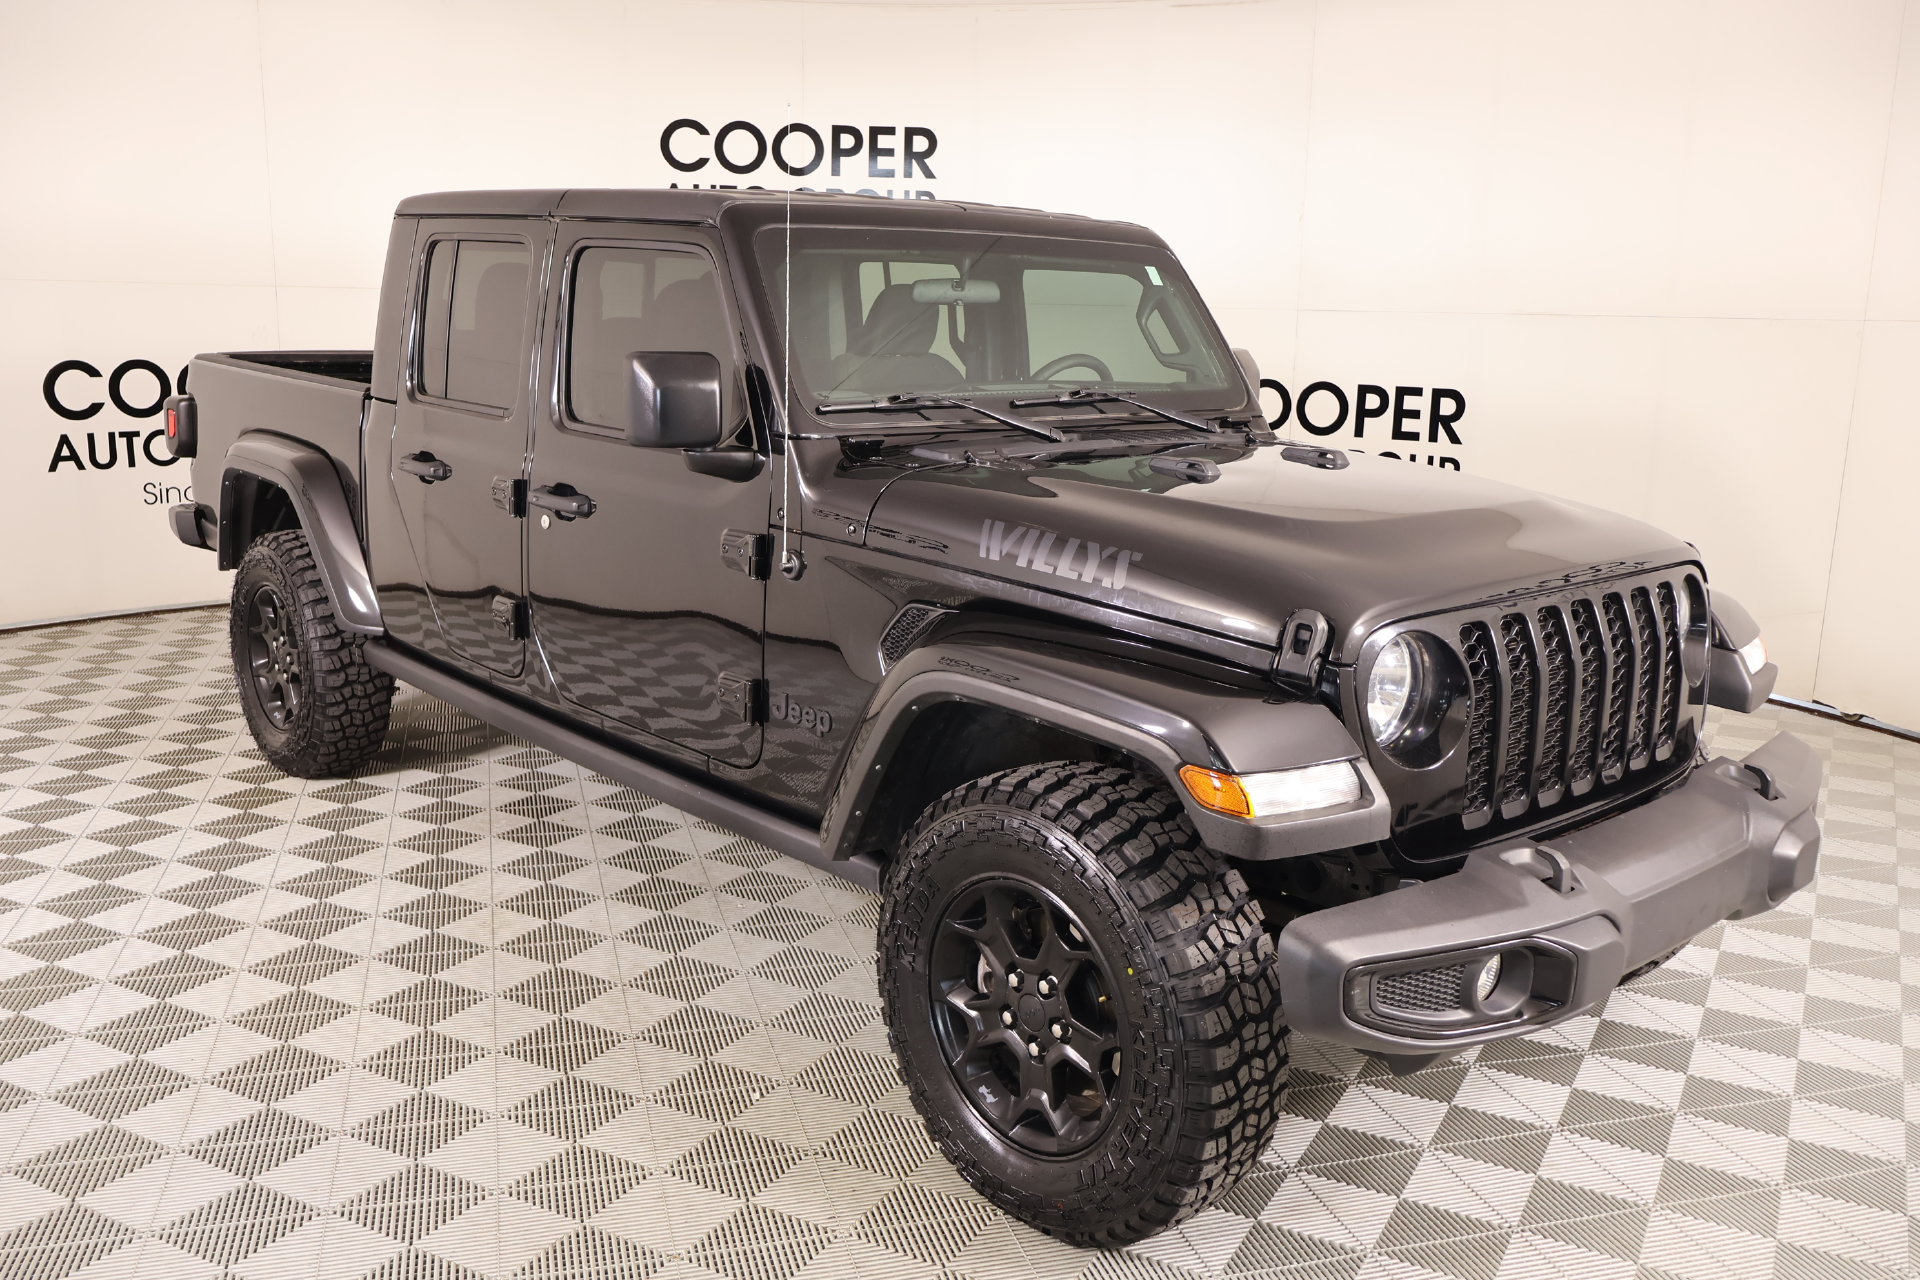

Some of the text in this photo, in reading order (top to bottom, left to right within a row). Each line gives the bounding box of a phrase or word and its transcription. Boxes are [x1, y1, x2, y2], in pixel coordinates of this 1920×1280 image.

[660, 118, 938, 179] COOPER
[43, 359, 190, 420] CO
[771, 692, 832, 738] Jeep
